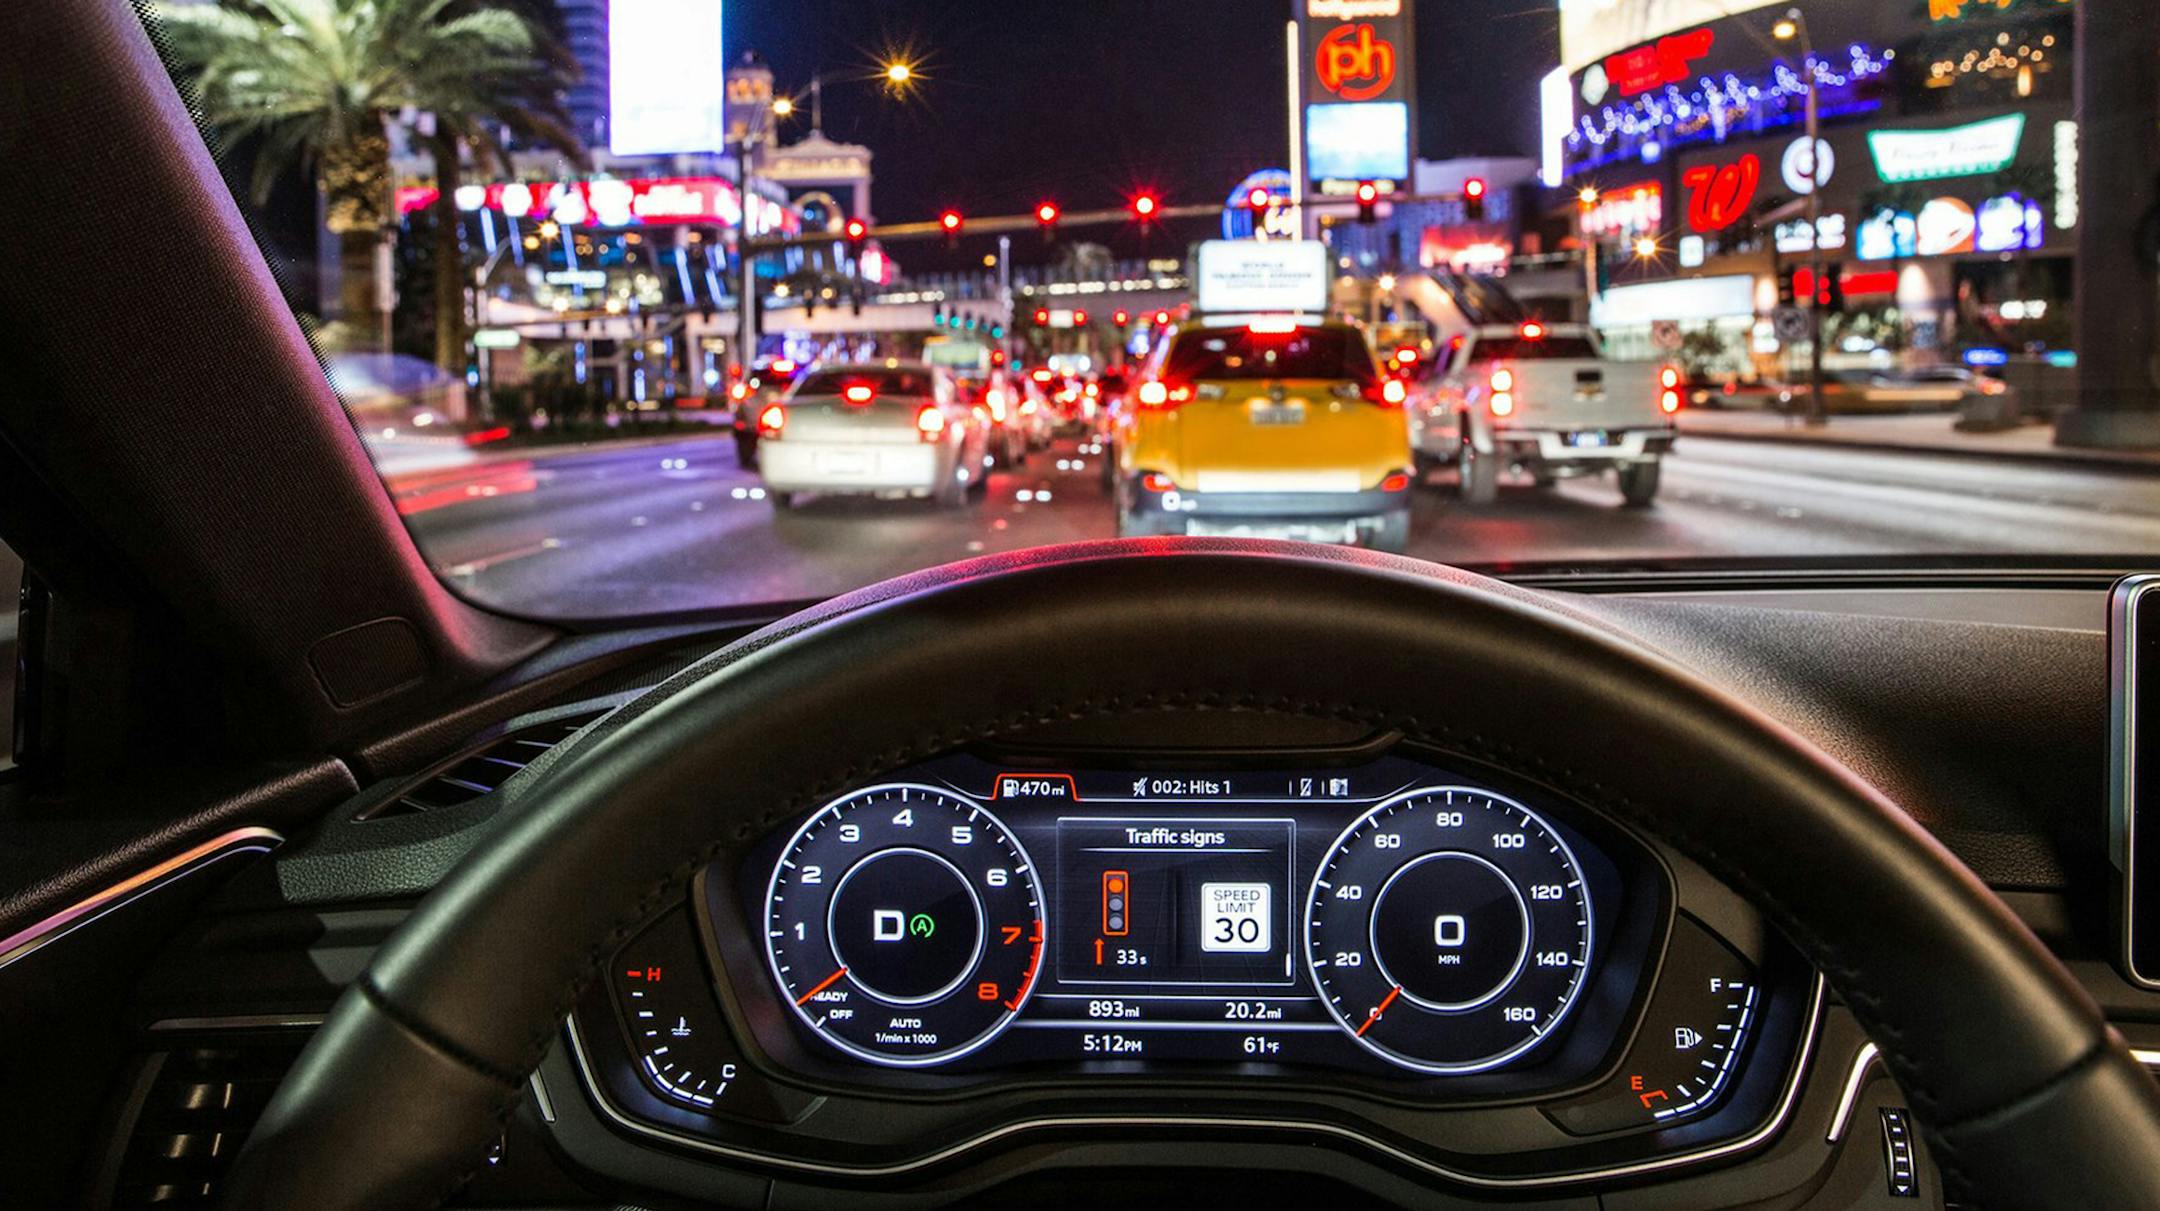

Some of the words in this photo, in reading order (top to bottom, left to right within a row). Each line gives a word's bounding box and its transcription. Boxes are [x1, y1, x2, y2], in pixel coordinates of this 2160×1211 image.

[1319, 24, 1396, 94] ph
[1152, 780, 1187, 794] 002:
[1190, 780, 1219, 794] Hits
[1223, 780, 1231, 794] 1
[892, 808, 913, 827] 4
[1436, 812, 1464, 827] 80
[839, 824, 860, 842] 3
[952, 826, 972, 844] 5
[1125, 829, 1178, 844] Traffic
[1180, 828, 1226, 848] signs
[1492, 833, 1525, 848] 100
[1374, 834, 1401, 848] 60
[801, 866, 822, 884] 2
[986, 869, 1008, 886] 6
[1213, 889, 1261, 901] SPEED
[1335, 885, 1362, 900] 40
[1530, 885, 1563, 900] 120
[1216, 902, 1256, 913] LIMIT
[794, 922, 805, 940] 1
[873, 909, 905, 941] D
[1214, 917, 1259, 943] 30
[1434, 914, 1465, 947] 0
[1001, 926, 1022, 945] 7
[1335, 952, 1362, 967] 20
[1438, 954, 1460, 965] MPH
[1536, 952, 1568, 967] 140
[646, 967, 662, 982] H
[977, 982, 998, 1000] 8
[1710, 978, 1722, 992] F
[829, 1009, 853, 1019] OFF
[1503, 1007, 1536, 1021] 160
[889, 1018, 922, 1028] AUTO
[874, 1032, 904, 1044] 1/min
[912, 1034, 937, 1044] 1000
[721, 1064, 736, 1078] C
[1630, 1075, 1643, 1091] E
